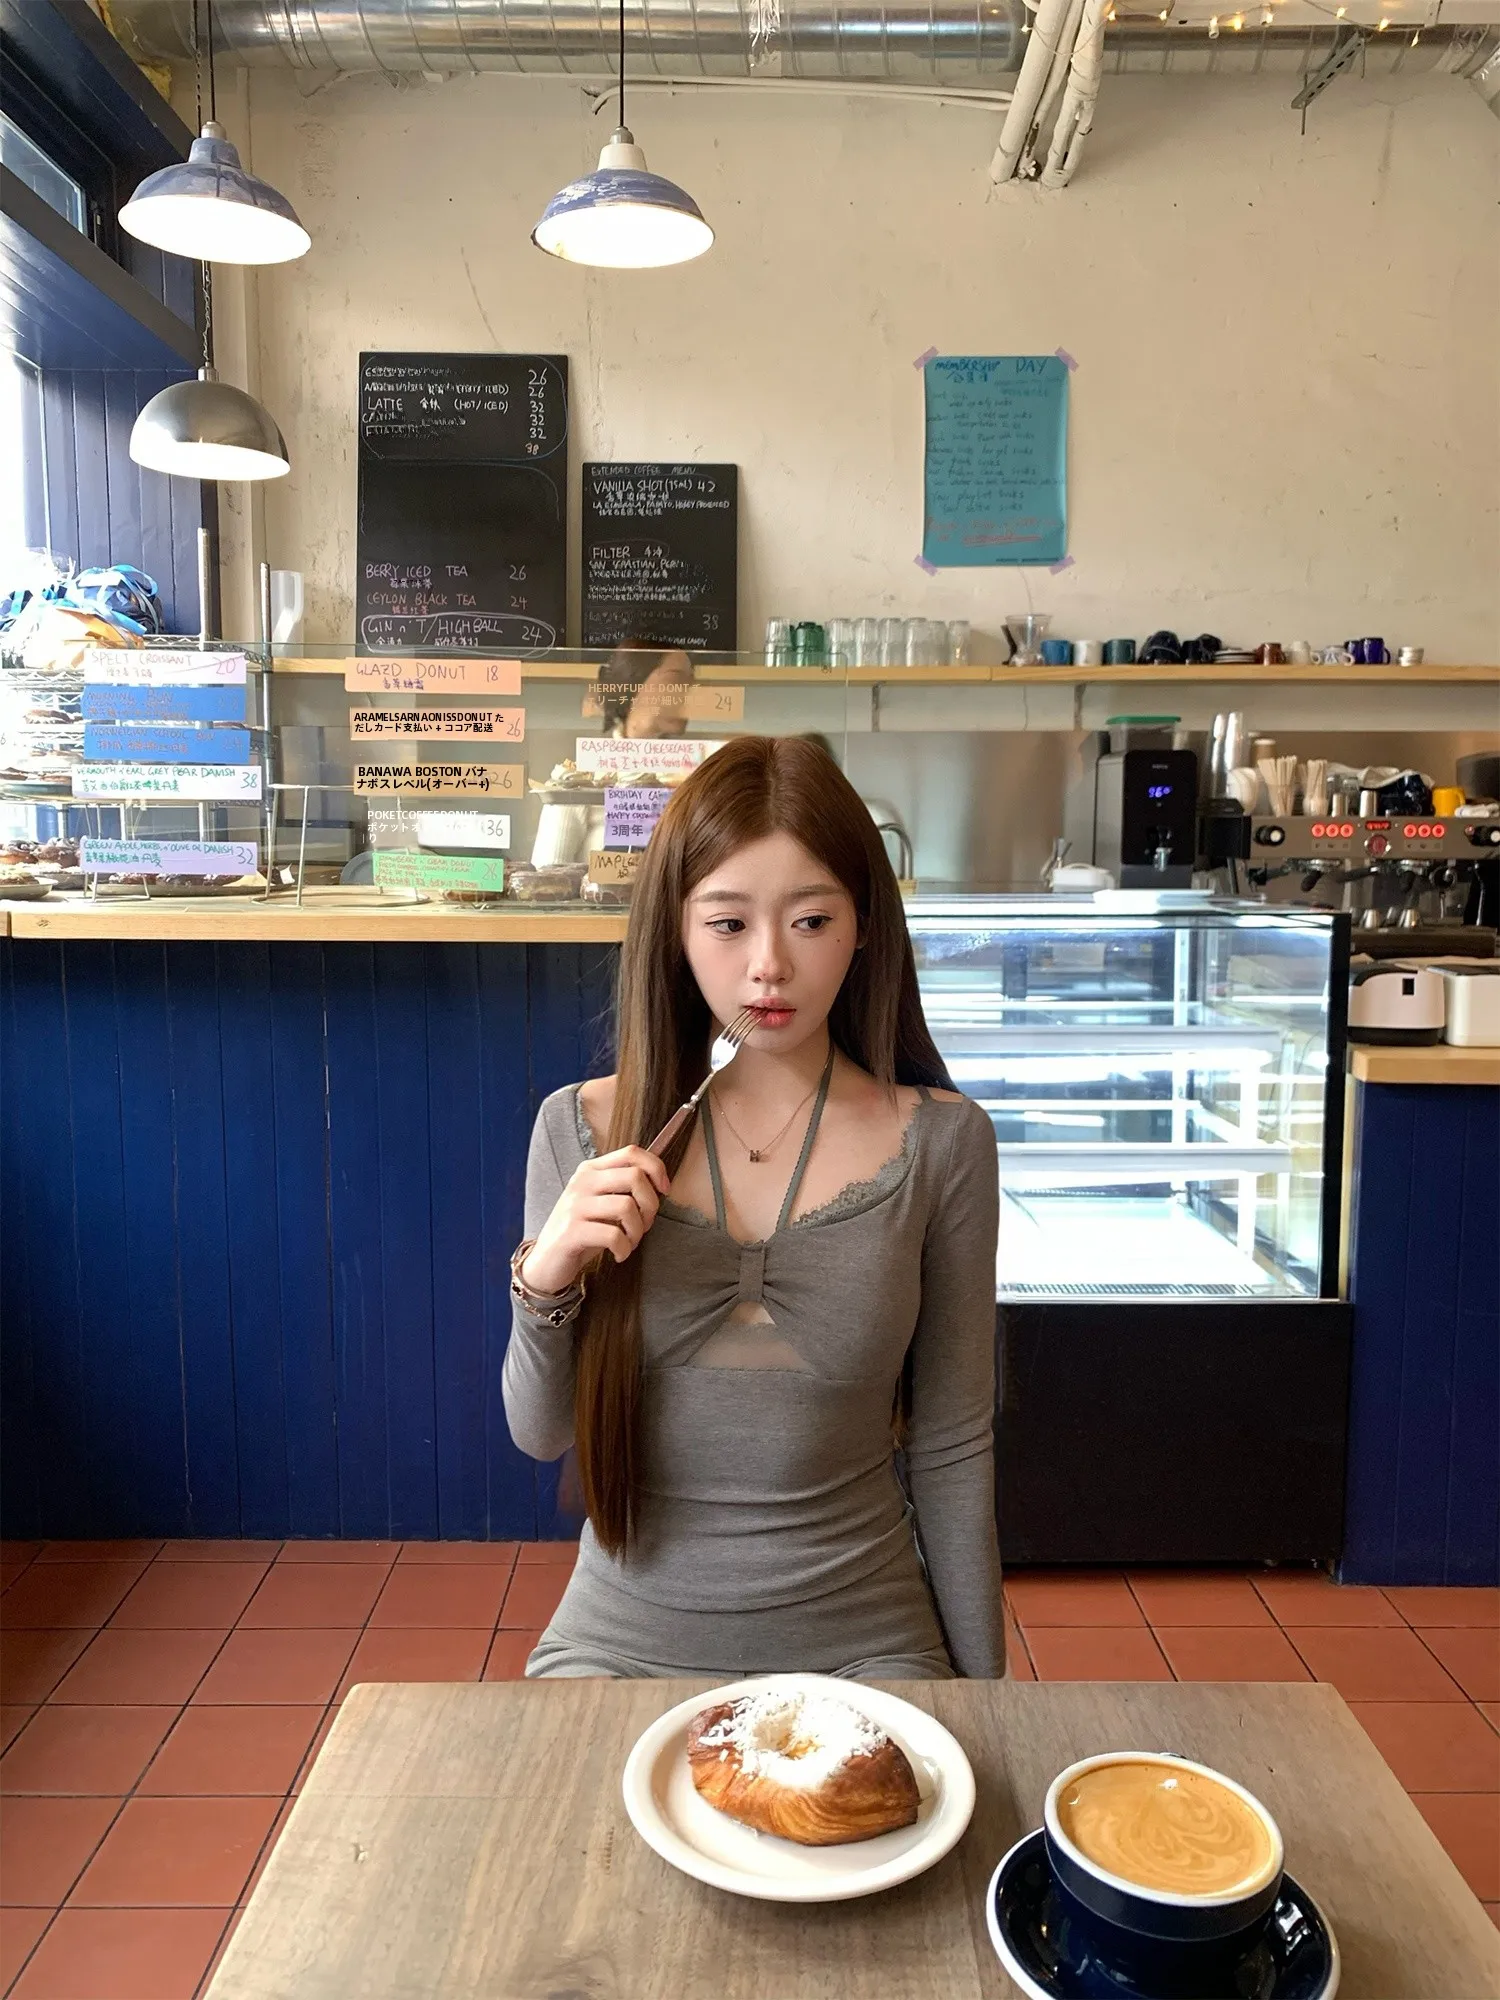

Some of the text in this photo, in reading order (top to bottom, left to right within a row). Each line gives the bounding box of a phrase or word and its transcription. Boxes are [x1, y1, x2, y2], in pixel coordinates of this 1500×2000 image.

[1016, 357, 1048, 374] DAY
[528, 367, 547, 385] 26
[528, 386, 545, 398] 26
[367, 397, 403, 412] LATTE
[529, 401, 545, 413] 32
[529, 414, 545, 426] 32
[529, 427, 547, 439] 32
[525, 442, 540, 455] 38
[697, 480, 716, 493] 42
[592, 545, 631, 559] FILTER
[365, 562, 527, 580] BERRY ICED TEA 26
[366, 592, 528, 610] CEYLON BLACK TEA 24
[702, 613, 719, 631] 38
[367, 619, 393, 633] GIN
[521, 620, 542, 646] 24
[415, 662, 466, 681] DONUT
[486, 665, 499, 682] 18
[506, 717, 521, 738] 26
[201, 768, 236, 778] DANISH
[240, 772, 258, 790] 38
[486, 819, 504, 837] 36
[611, 824, 644, 837] 3周年
[203, 844, 234, 856] DANISH
[236, 845, 254, 866] 32
